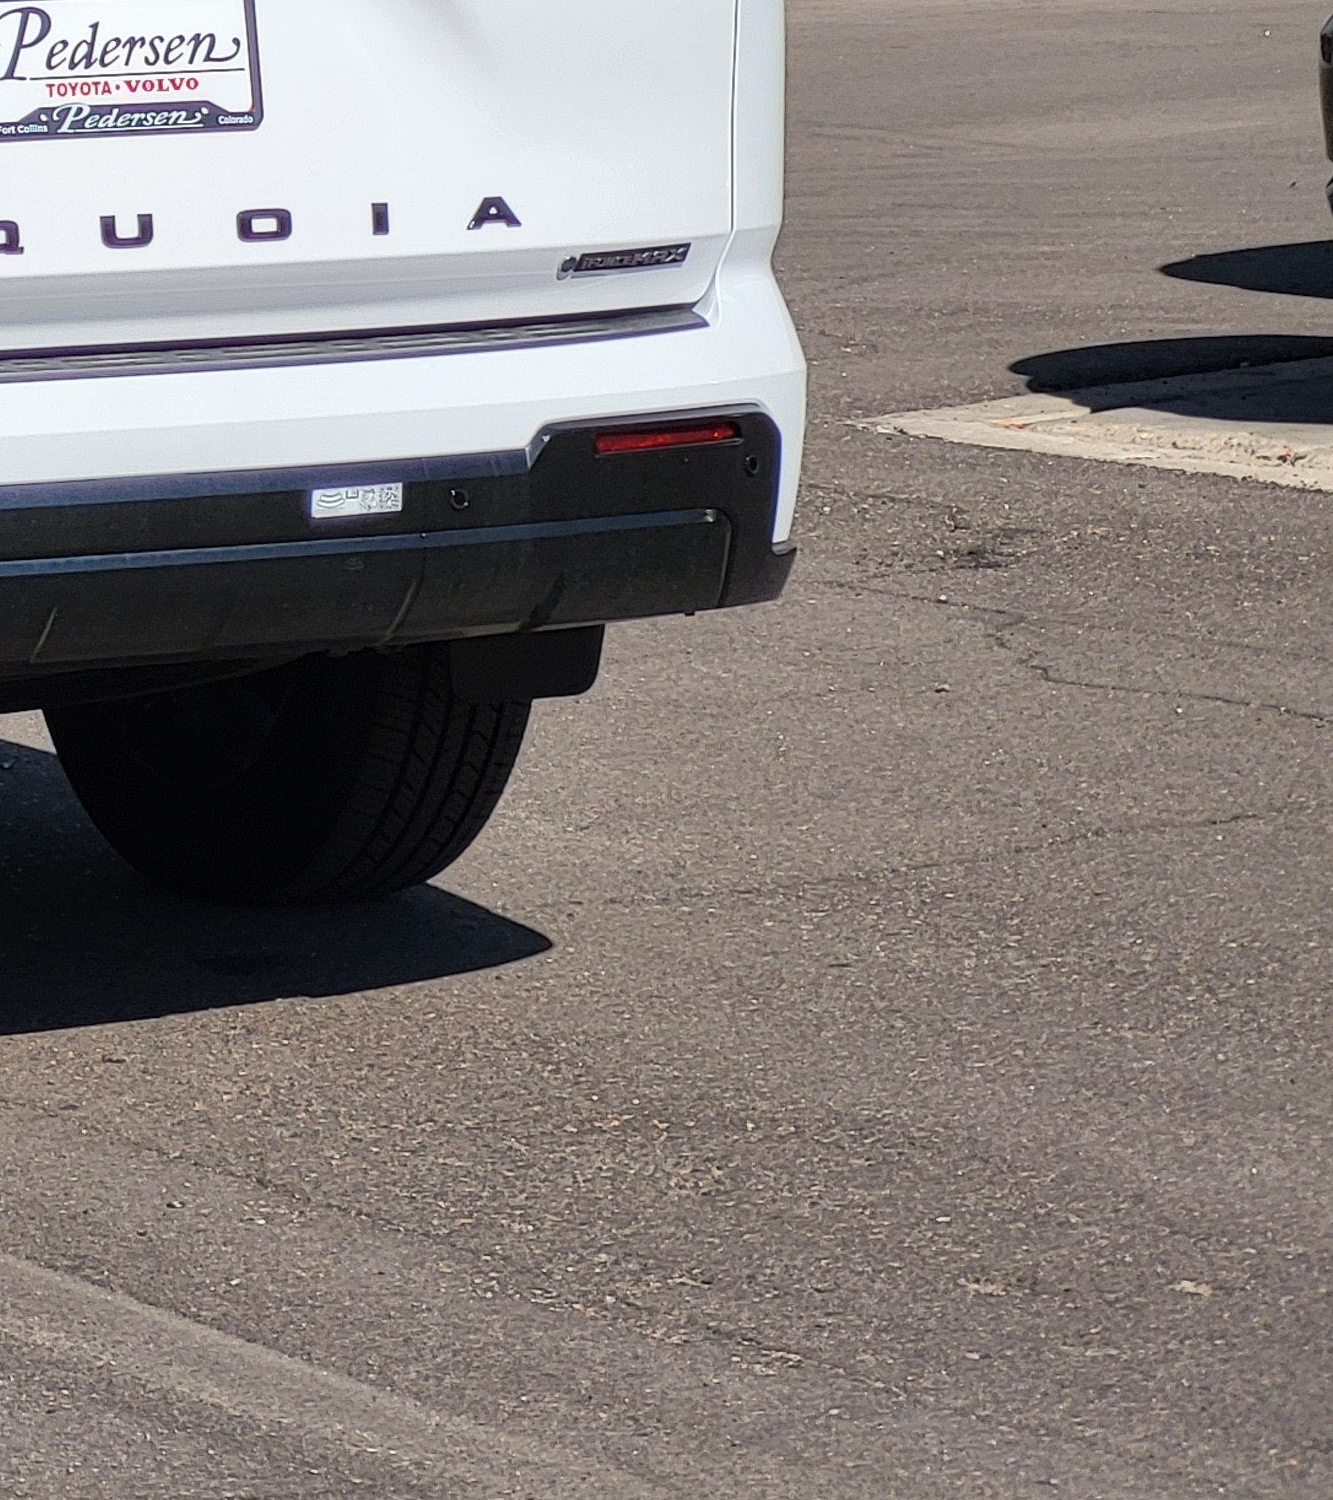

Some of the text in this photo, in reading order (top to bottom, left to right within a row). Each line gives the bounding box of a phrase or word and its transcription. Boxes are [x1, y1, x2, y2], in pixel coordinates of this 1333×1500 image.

[46, 77, 199, 98] TOYOTA VOLVO
[52, 102, 203, 133] Pedersen
[218, 115, 254, 125] Colorado
